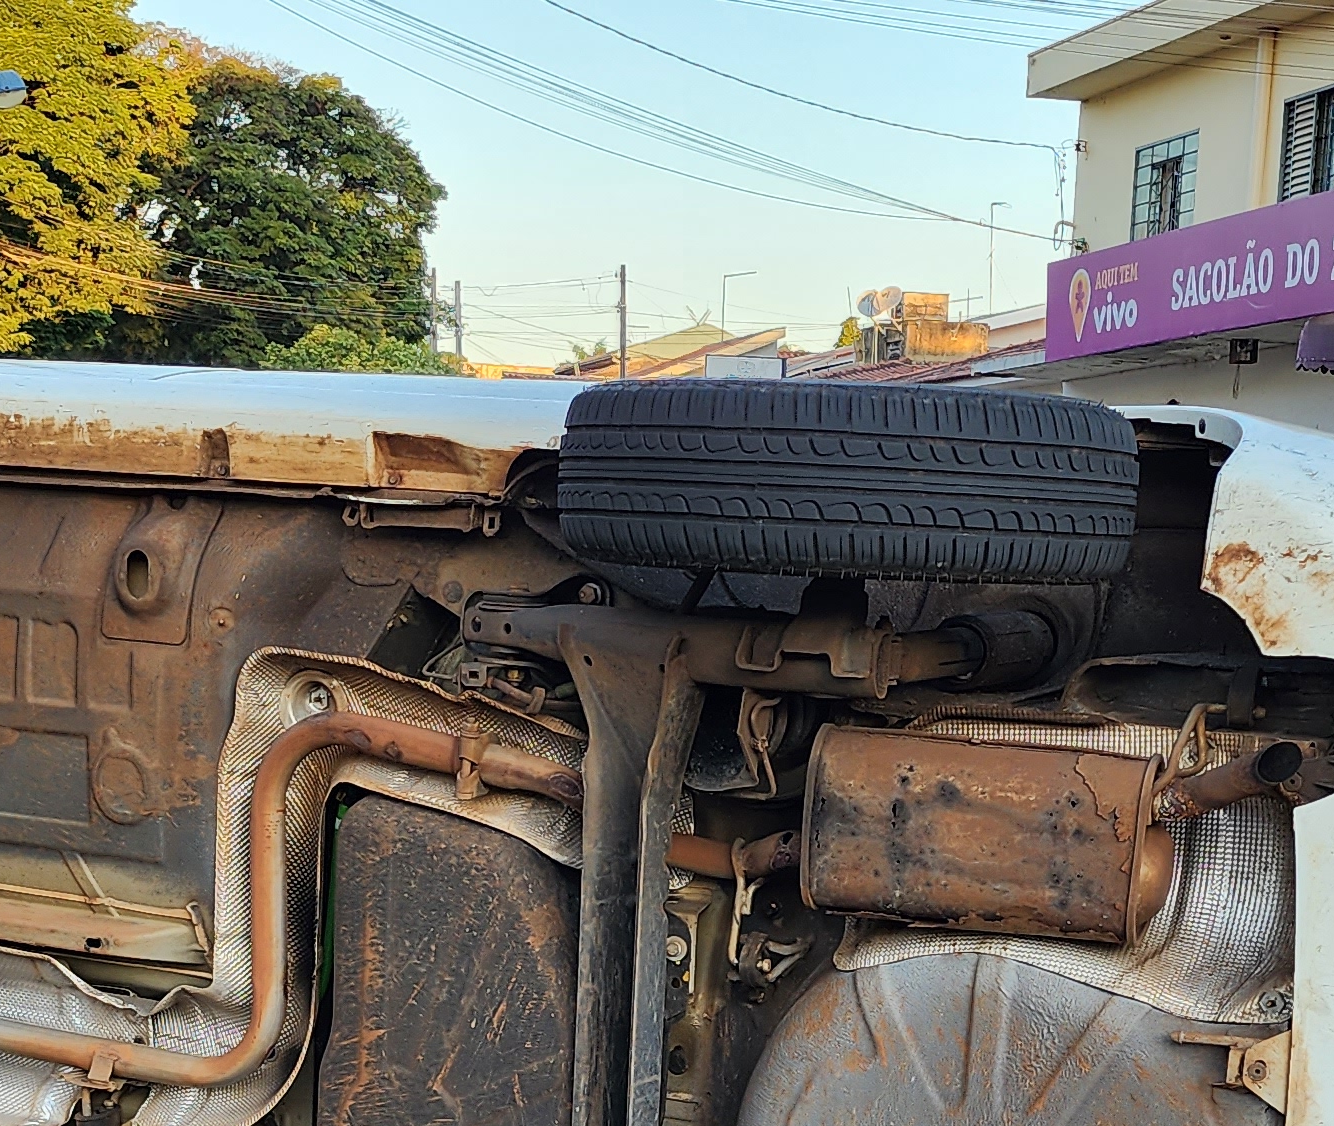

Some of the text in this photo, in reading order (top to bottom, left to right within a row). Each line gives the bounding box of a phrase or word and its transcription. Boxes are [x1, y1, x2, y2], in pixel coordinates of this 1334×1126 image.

[1094, 261, 1139, 291] AQUI TEM
[1171, 239, 1274, 311] SACOLÃO
[1285, 238, 1320, 289] DO
[1093, 291, 1138, 334] vivo
